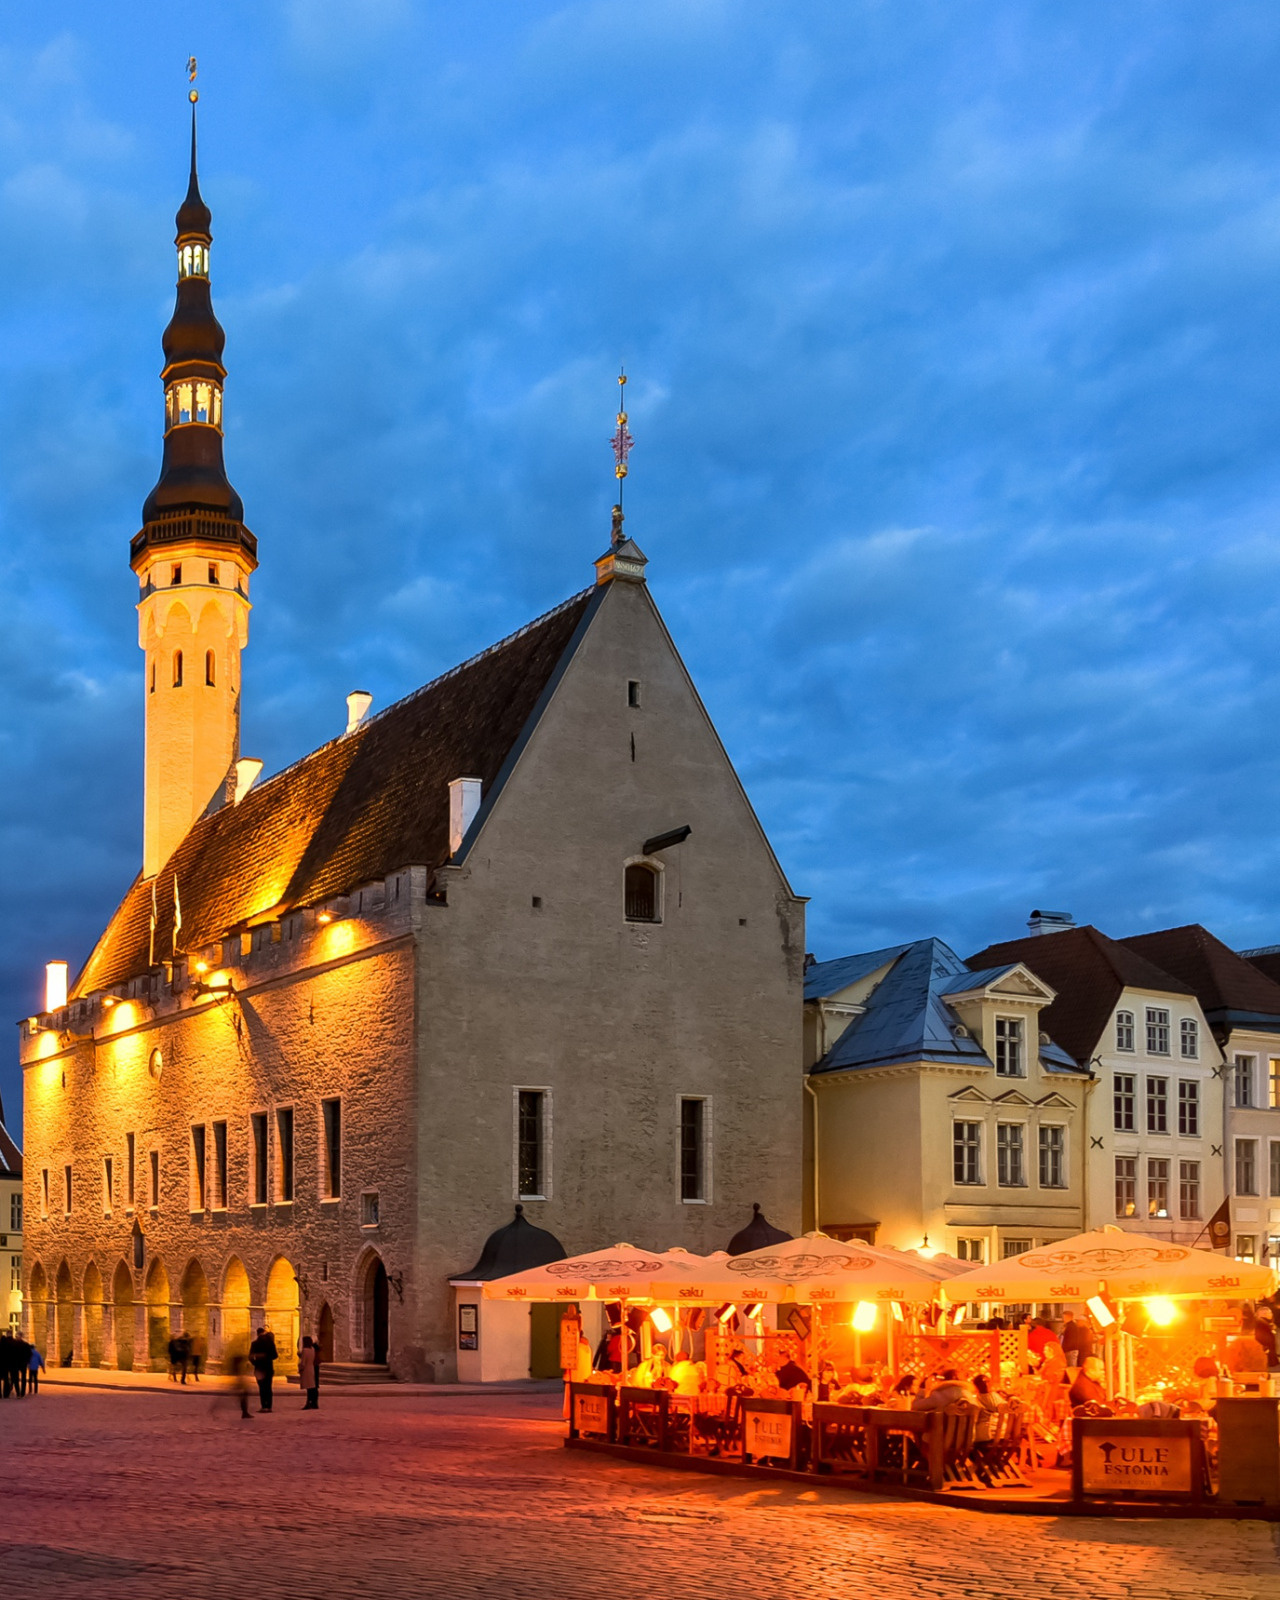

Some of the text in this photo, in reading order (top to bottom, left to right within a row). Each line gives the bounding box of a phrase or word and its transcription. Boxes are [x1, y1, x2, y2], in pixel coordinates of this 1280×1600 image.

[1207, 1275, 1241, 1289] saku
[678, 1286, 704, 1298] saku
[741, 1287, 768, 1299] saku
[808, 1287, 836, 1300] saku
[976, 1285, 1005, 1298] saku
[1050, 1284, 1080, 1297] saku
[1104, 1464, 1169, 1476] ESTONIA
